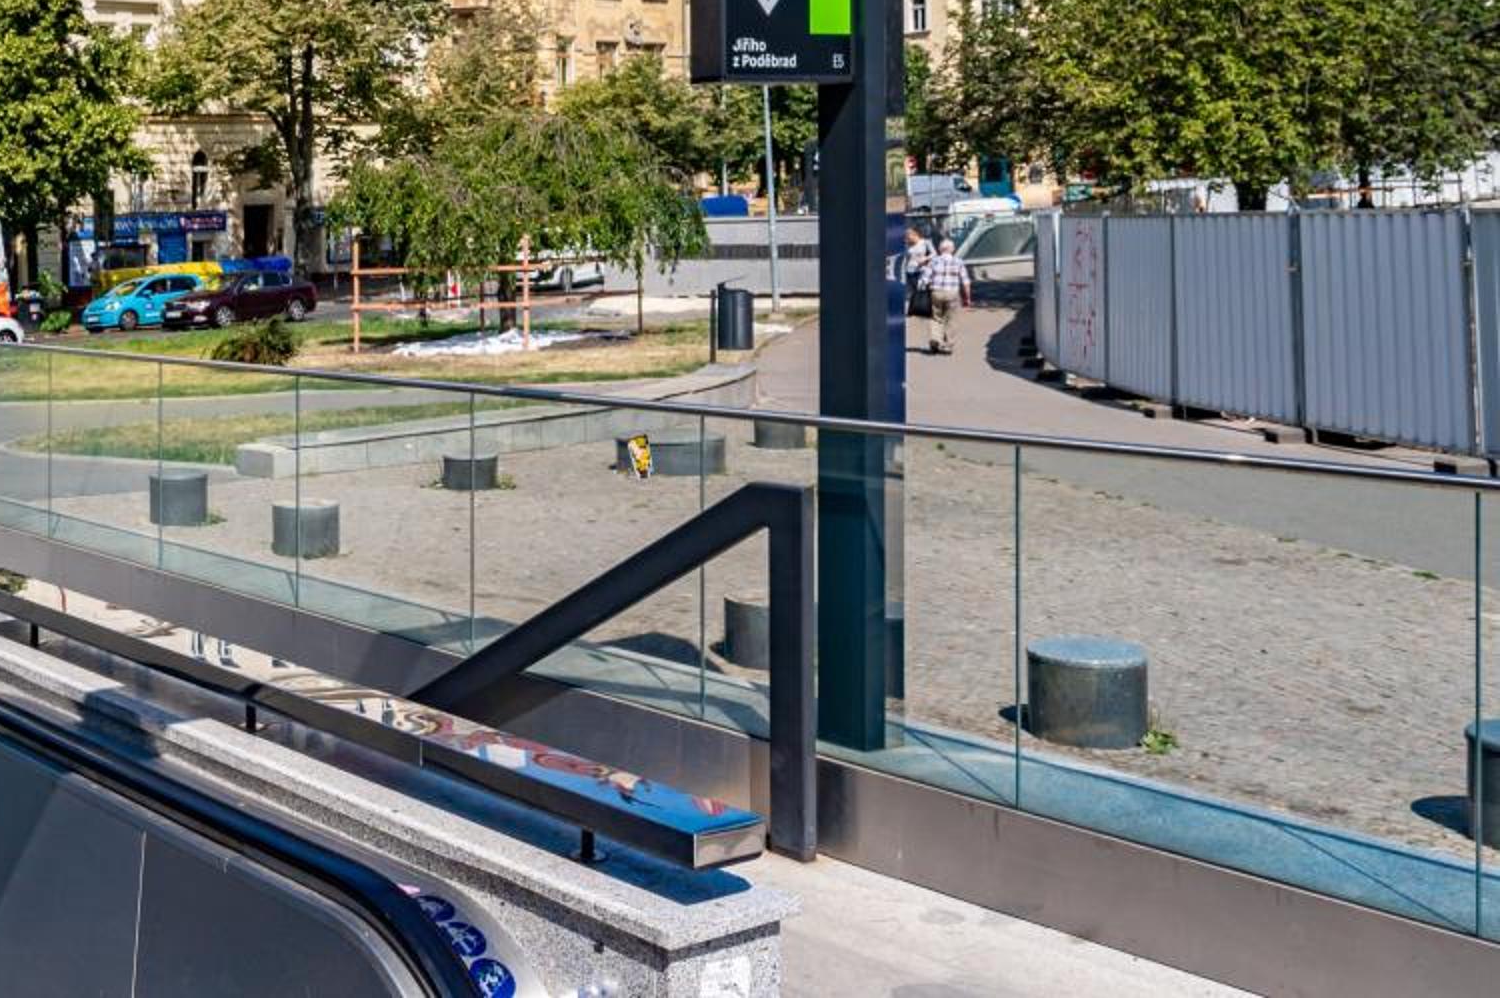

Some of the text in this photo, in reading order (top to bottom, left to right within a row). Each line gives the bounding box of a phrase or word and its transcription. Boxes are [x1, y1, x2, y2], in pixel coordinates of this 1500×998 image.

[733, 38, 767, 52] Jiřího
[734, 54, 797, 68] z Poděbrad
